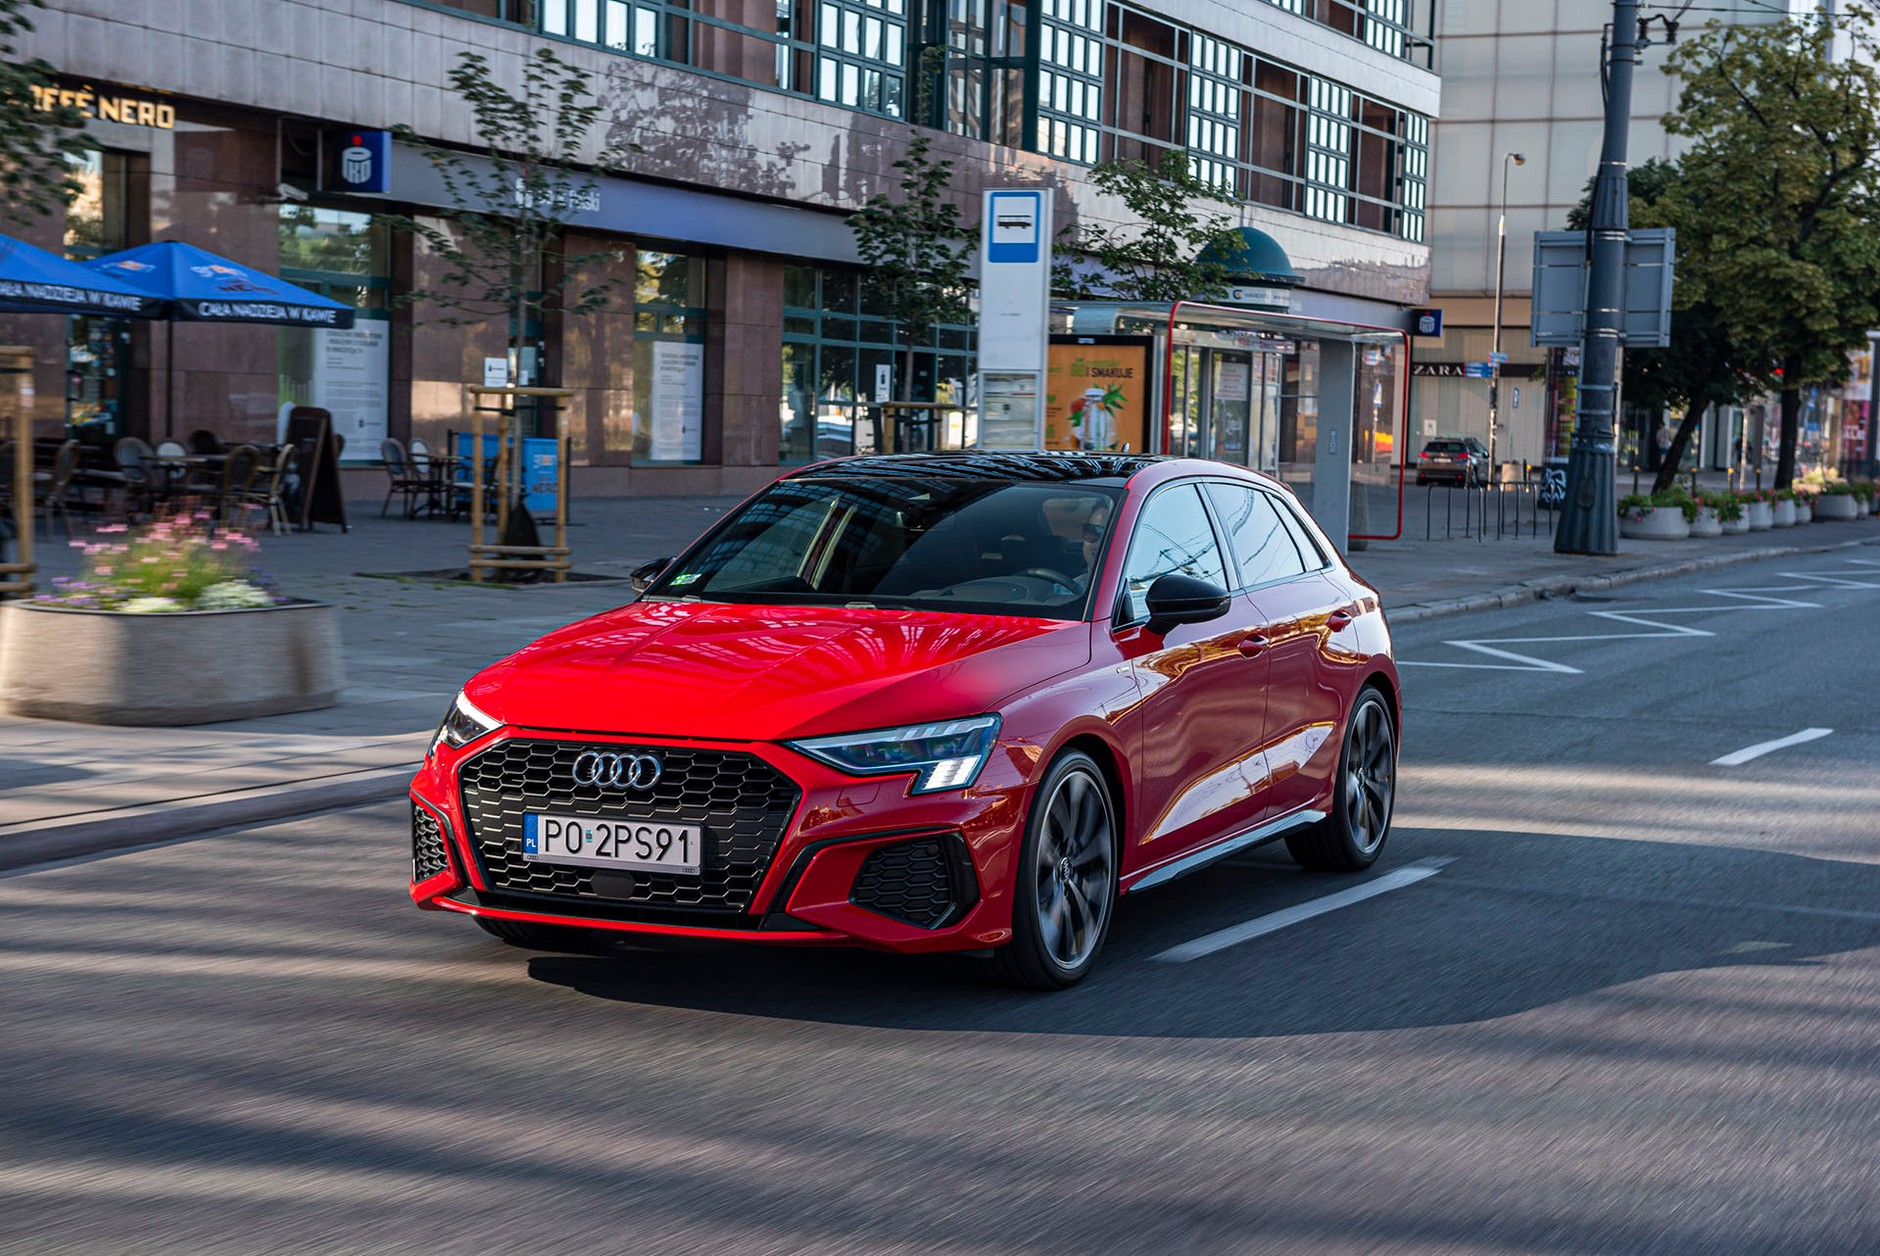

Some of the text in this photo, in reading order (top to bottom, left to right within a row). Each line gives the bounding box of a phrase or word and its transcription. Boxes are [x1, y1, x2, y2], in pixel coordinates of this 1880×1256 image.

[99, 96, 175, 129] NERO
[25, 285, 88, 303] NADZIEJA
[87, 290, 100, 304] W
[199, 302, 336, 324] CAŁA NADZIEJA W KAWIE
[1091, 367, 1134, 379] SMAKUJE
[1413, 364, 1463, 376] ZARA
[526, 838, 537, 848] PL
[595, 823, 688, 863] 2PS91
